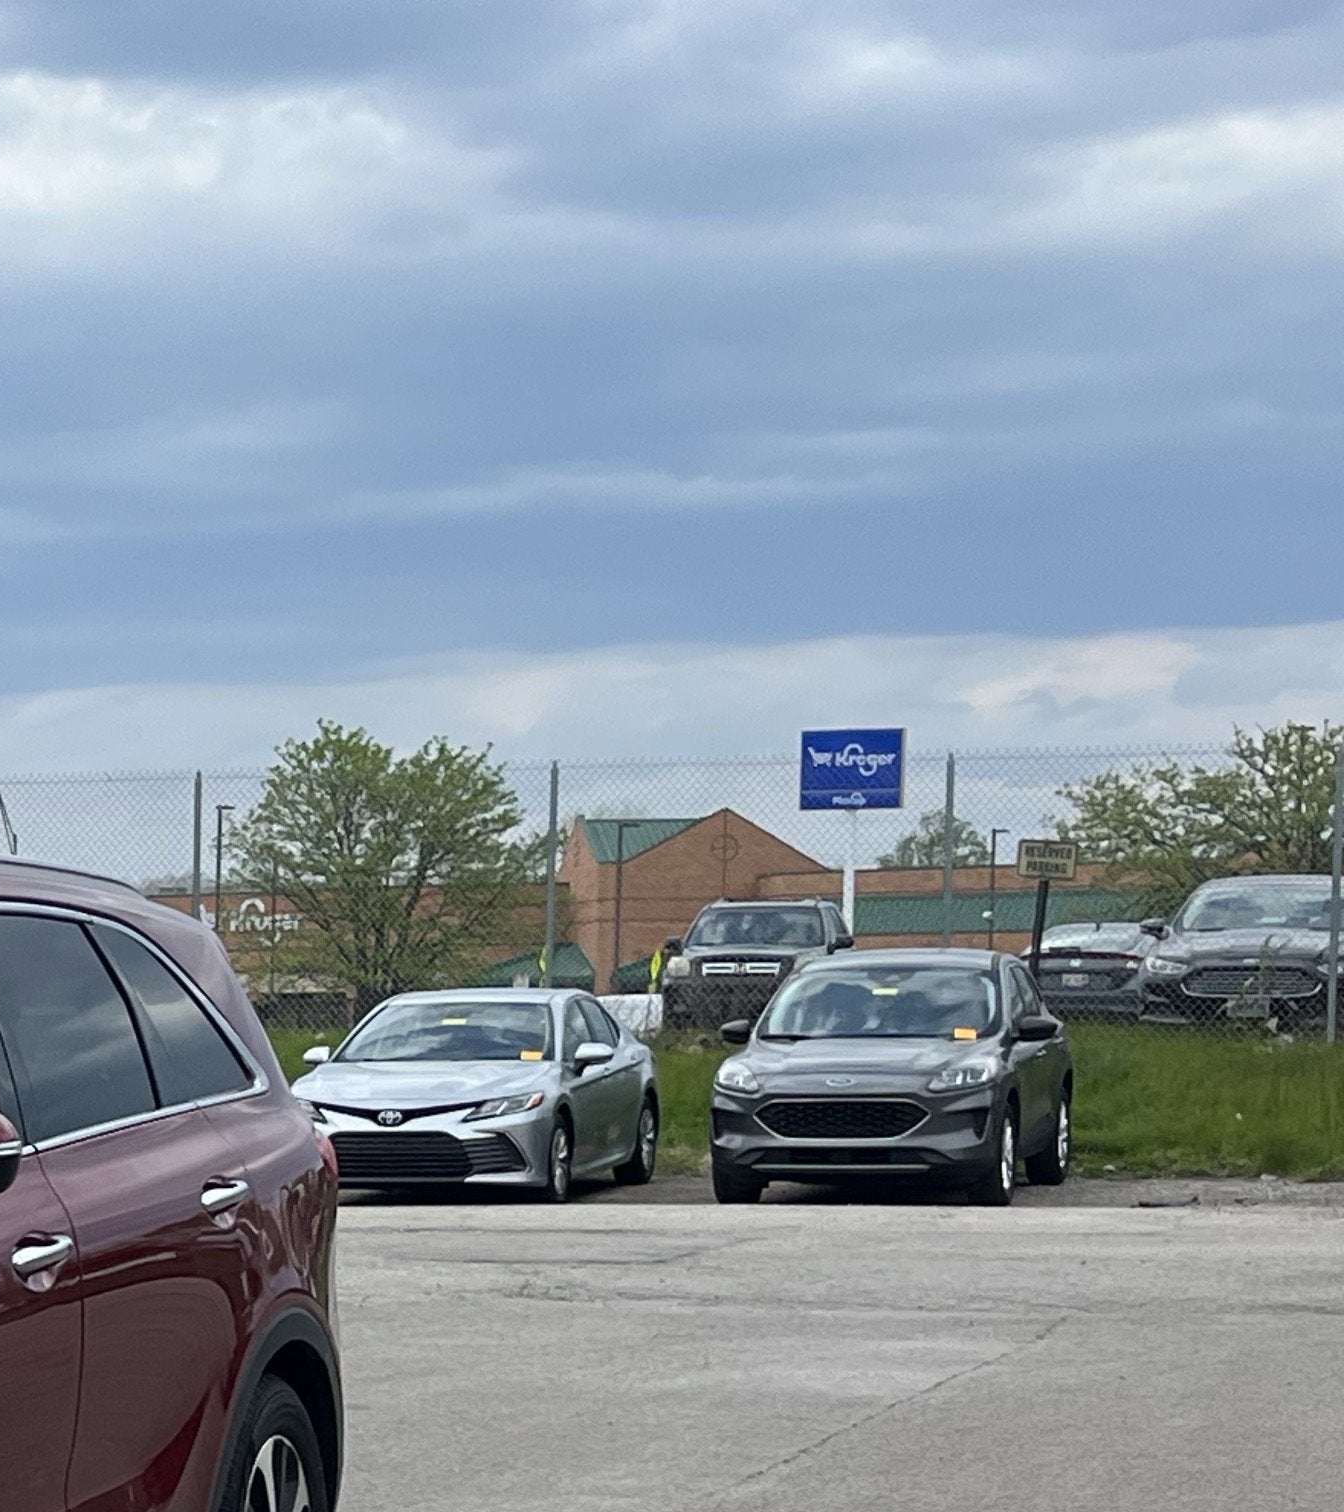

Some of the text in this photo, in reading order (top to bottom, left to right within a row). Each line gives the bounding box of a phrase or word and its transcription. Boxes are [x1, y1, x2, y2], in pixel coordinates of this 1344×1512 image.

[835, 743, 896, 776] Kroger
[1025, 845, 1072, 859] RESERVED
[1026, 860, 1067, 873] PARKING
